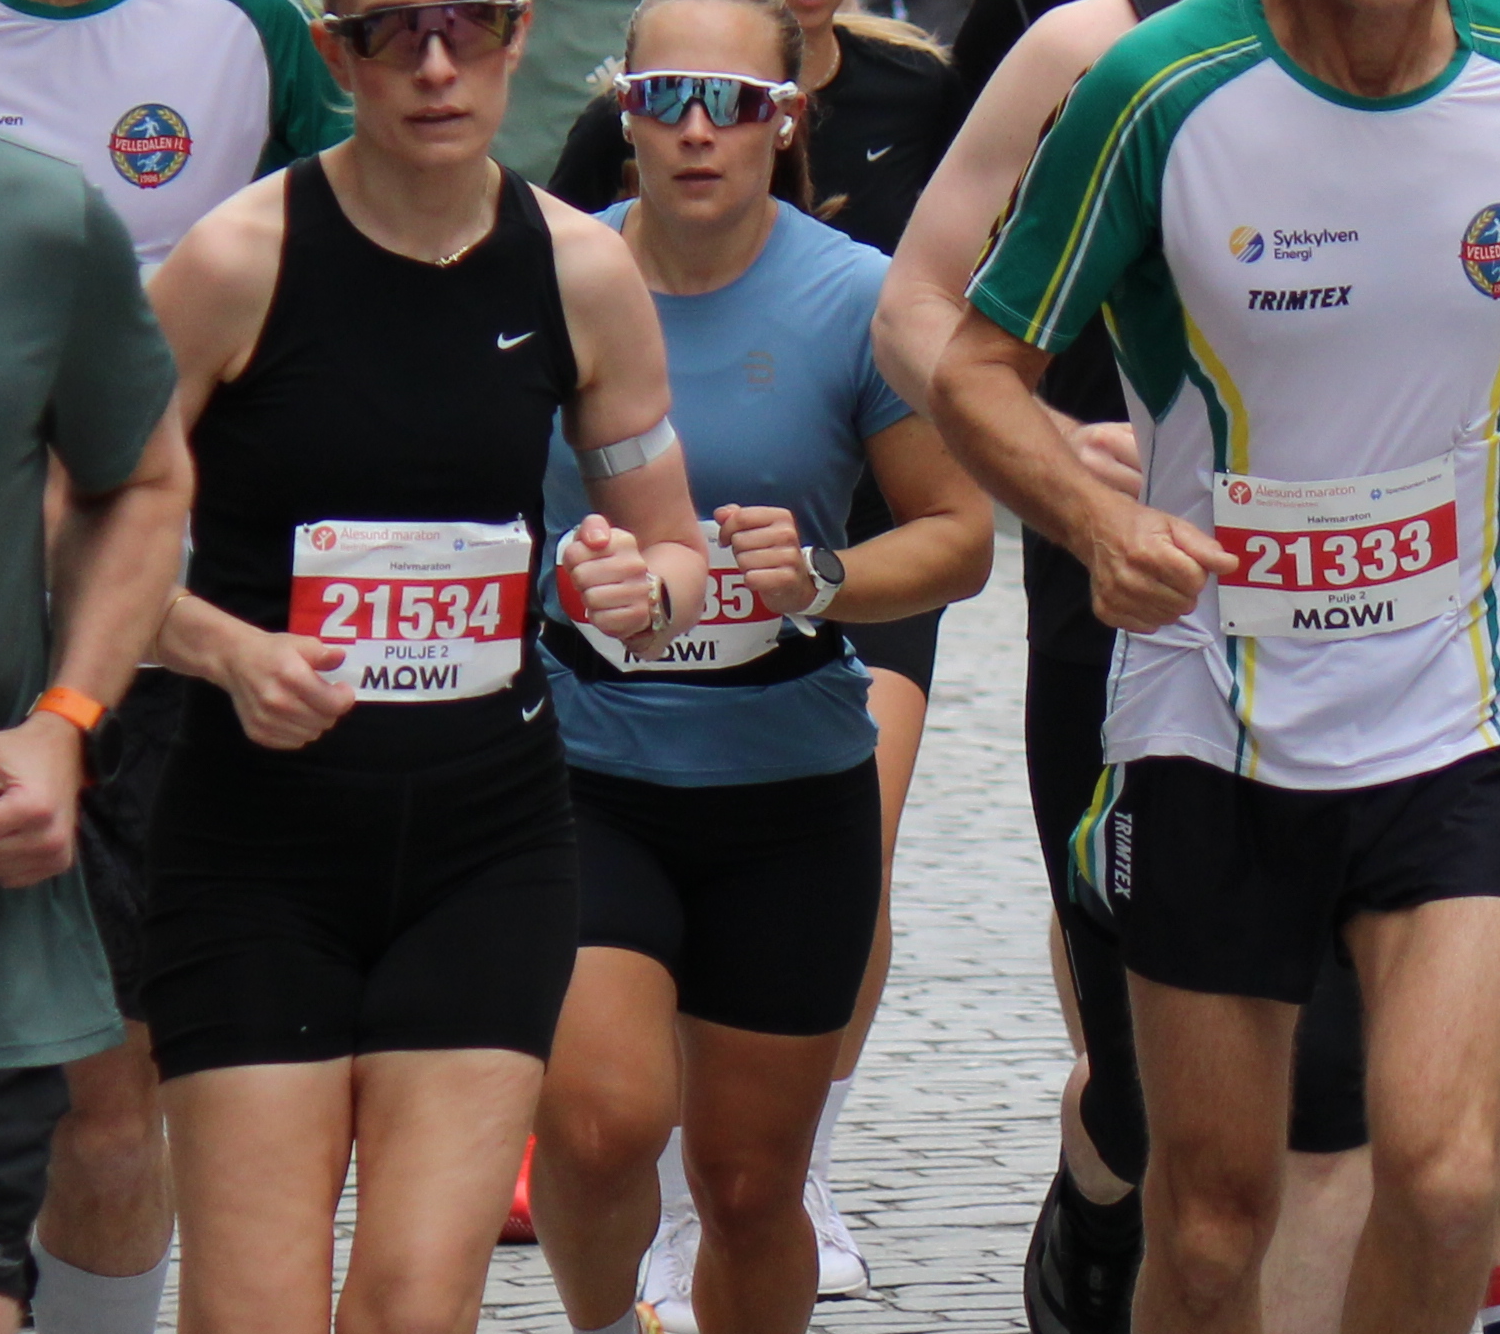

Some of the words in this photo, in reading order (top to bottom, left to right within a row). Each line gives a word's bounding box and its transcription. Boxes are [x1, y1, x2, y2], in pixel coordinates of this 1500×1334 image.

[114, 136, 172, 153] VELLEDALEN
[1273, 229, 1359, 247] Sykkylven
[1274, 247, 1313, 262] Energi
[1248, 285, 1353, 312] TRIMTEX
[1255, 484, 1303, 499] Ålesund
[1305, 484, 1356, 499] maraton
[1307, 511, 1372, 525] Halvmaraton
[340, 526, 389, 542] Ålesund
[391, 529, 441, 542] maraton
[1245, 519, 1433, 587] 21333
[389, 561, 452, 572] Halvmaraton
[1328, 593, 1356, 605] Pulje
[1358, 591, 1367, 601] 2
[319, 582, 501, 640] 21534
[384, 645, 436, 660] PULJE
[440, 645, 450, 658] 2
[1114, 811, 1133, 901] TRIMTEX
